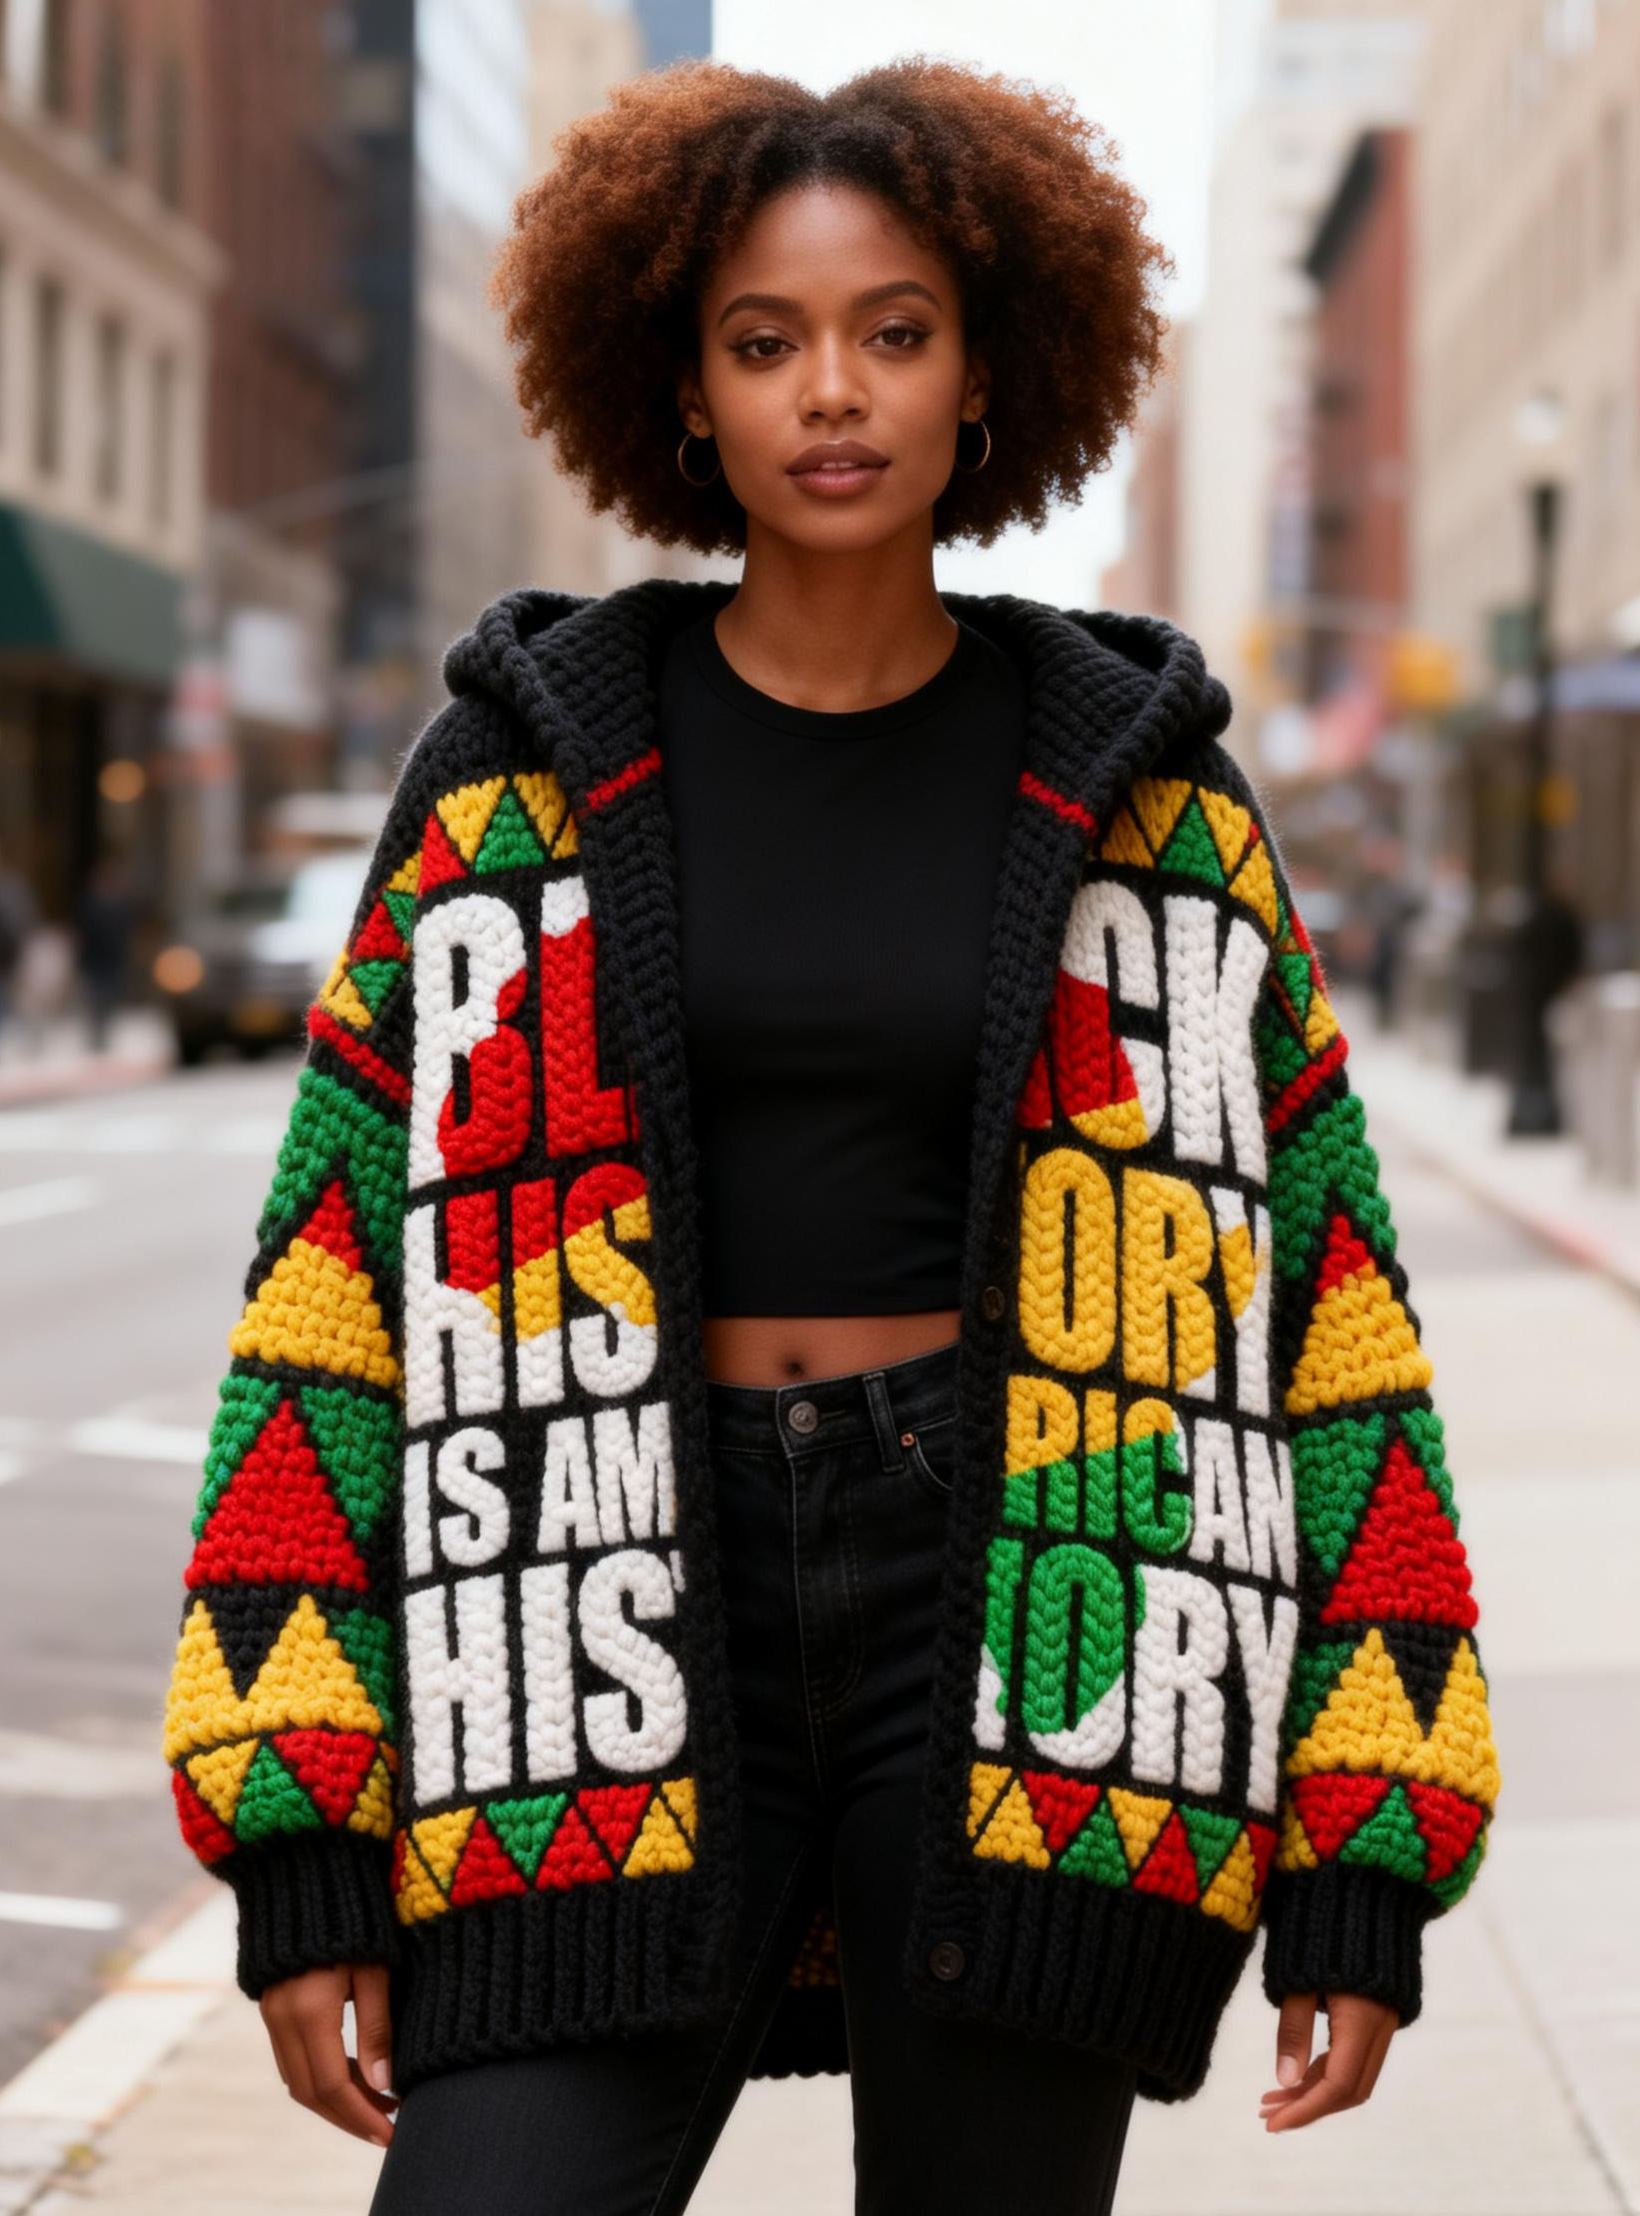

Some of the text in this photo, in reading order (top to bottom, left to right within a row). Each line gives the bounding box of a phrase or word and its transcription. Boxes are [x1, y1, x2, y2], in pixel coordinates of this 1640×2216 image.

[407, 876, 1269, 1191] BL CK
[403, 1163, 657, 1419] HIS
[403, 1375, 1298, 1587] IS AM RICAN
[406, 1550, 687, 1807] HIS
